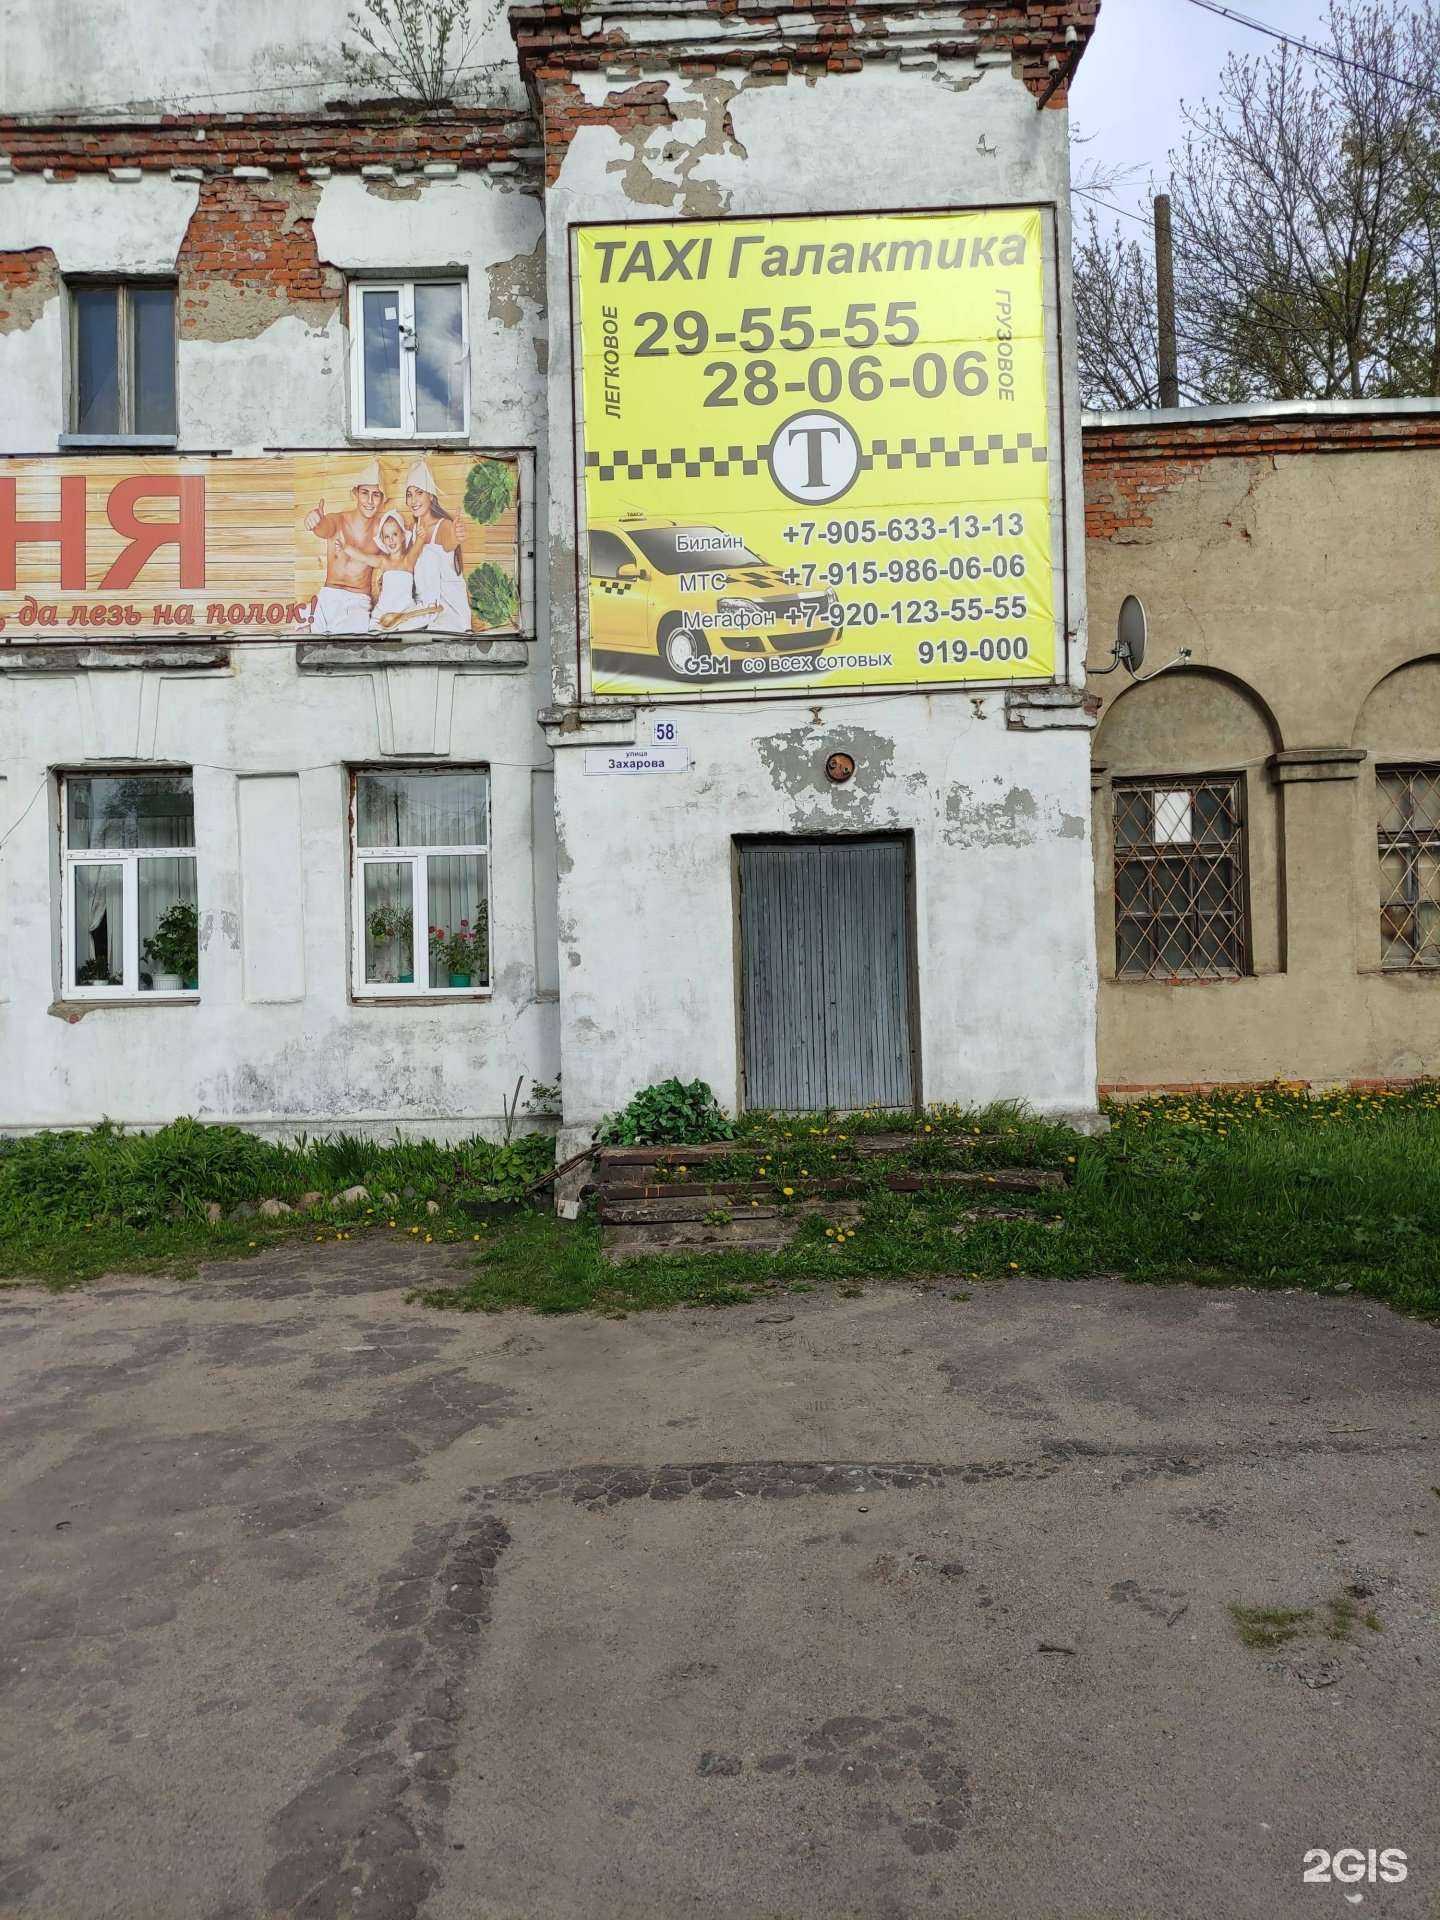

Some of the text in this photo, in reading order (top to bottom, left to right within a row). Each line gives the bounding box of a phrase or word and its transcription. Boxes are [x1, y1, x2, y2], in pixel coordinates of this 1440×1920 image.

[594, 232, 1026, 283] TAXI Галактика
[634, 301, 919, 358] 29-55-55
[995, 289, 1014, 401] ГРУЗОВОЕ
[604, 305, 621, 419] ЛЕГКОВОЕ
[703, 351, 989, 407] 28-06-06
[676, 513, 1024, 552] Билайн +7-905-633-13-13
[679, 555, 1025, 592] МТС +7-915-986-06-06
[67, 604, 142, 627] лезь
[152, 604, 195, 626] на
[206, 596, 318, 627] полок!
[683, 596, 1027, 631] Мегафон +7-920-123-55-55
[684, 652, 892, 674] GSM со всех сотовых
[919, 637, 1028, 664] 919-000
[656, 723, 675, 740] 58
[608, 759, 665, 770] Захарова
